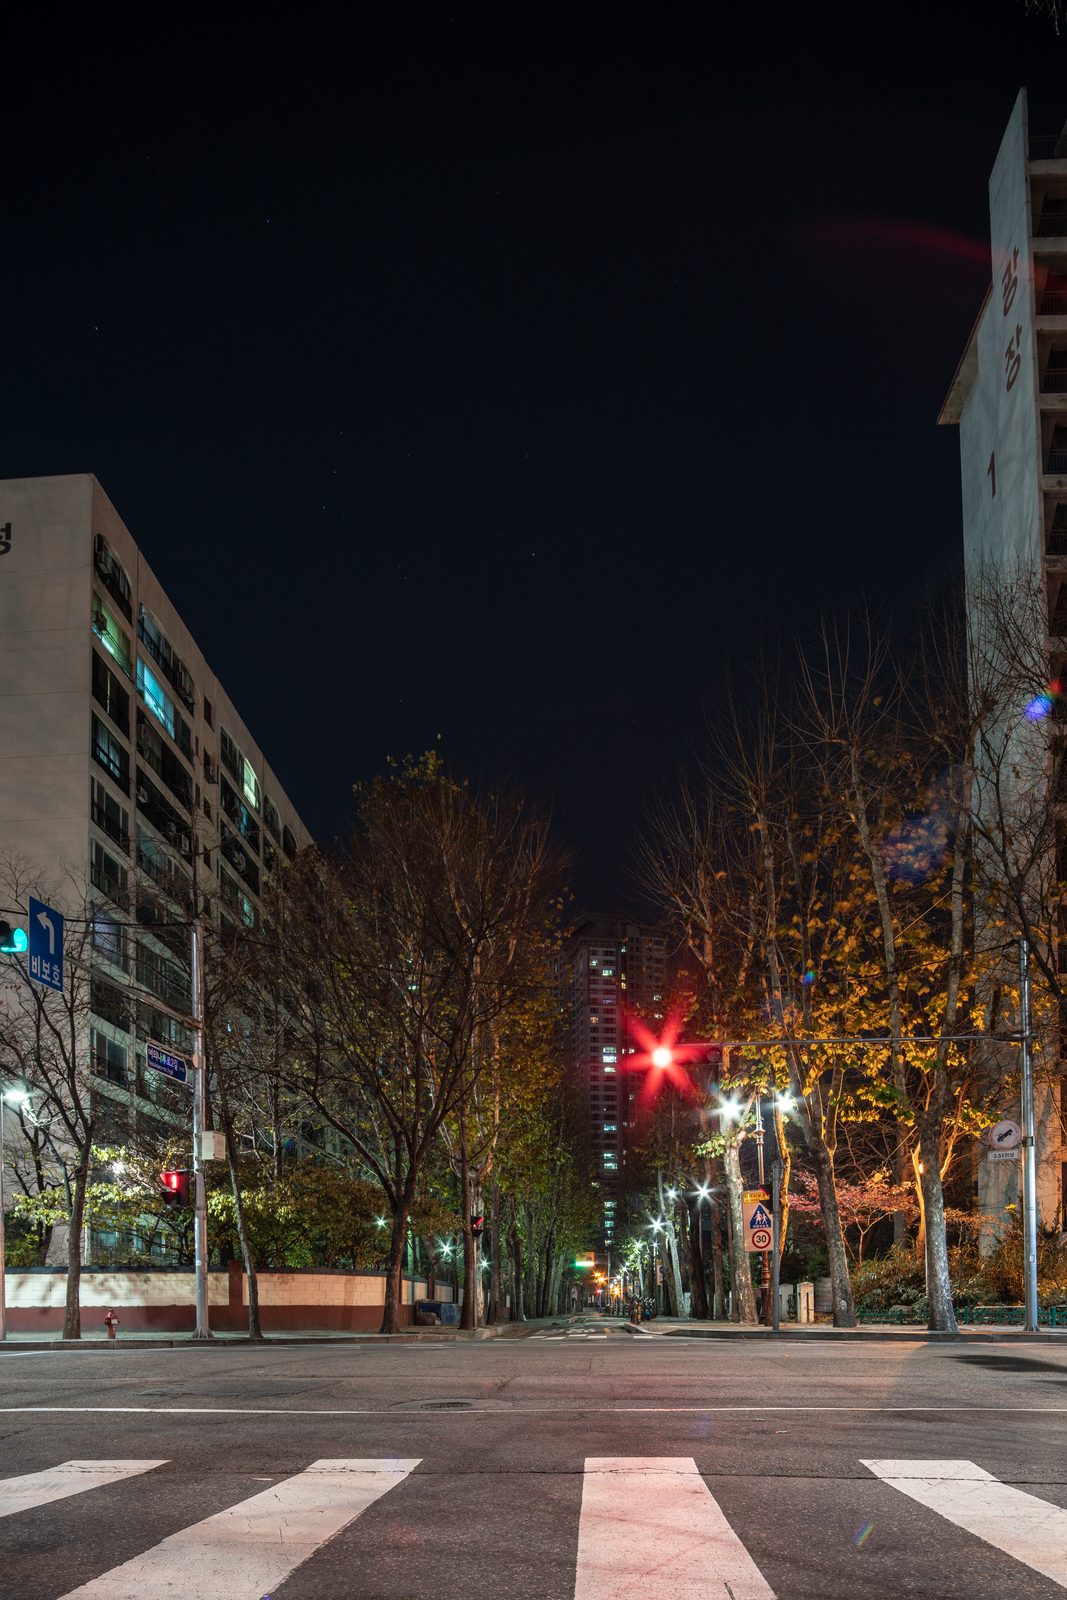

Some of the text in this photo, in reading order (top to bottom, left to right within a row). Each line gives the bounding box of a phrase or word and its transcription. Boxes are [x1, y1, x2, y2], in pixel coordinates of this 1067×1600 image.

[987, 449, 997, 499] 1
[31, 955, 61, 987] 비보호
[756, 1235, 767, 1243] 30
